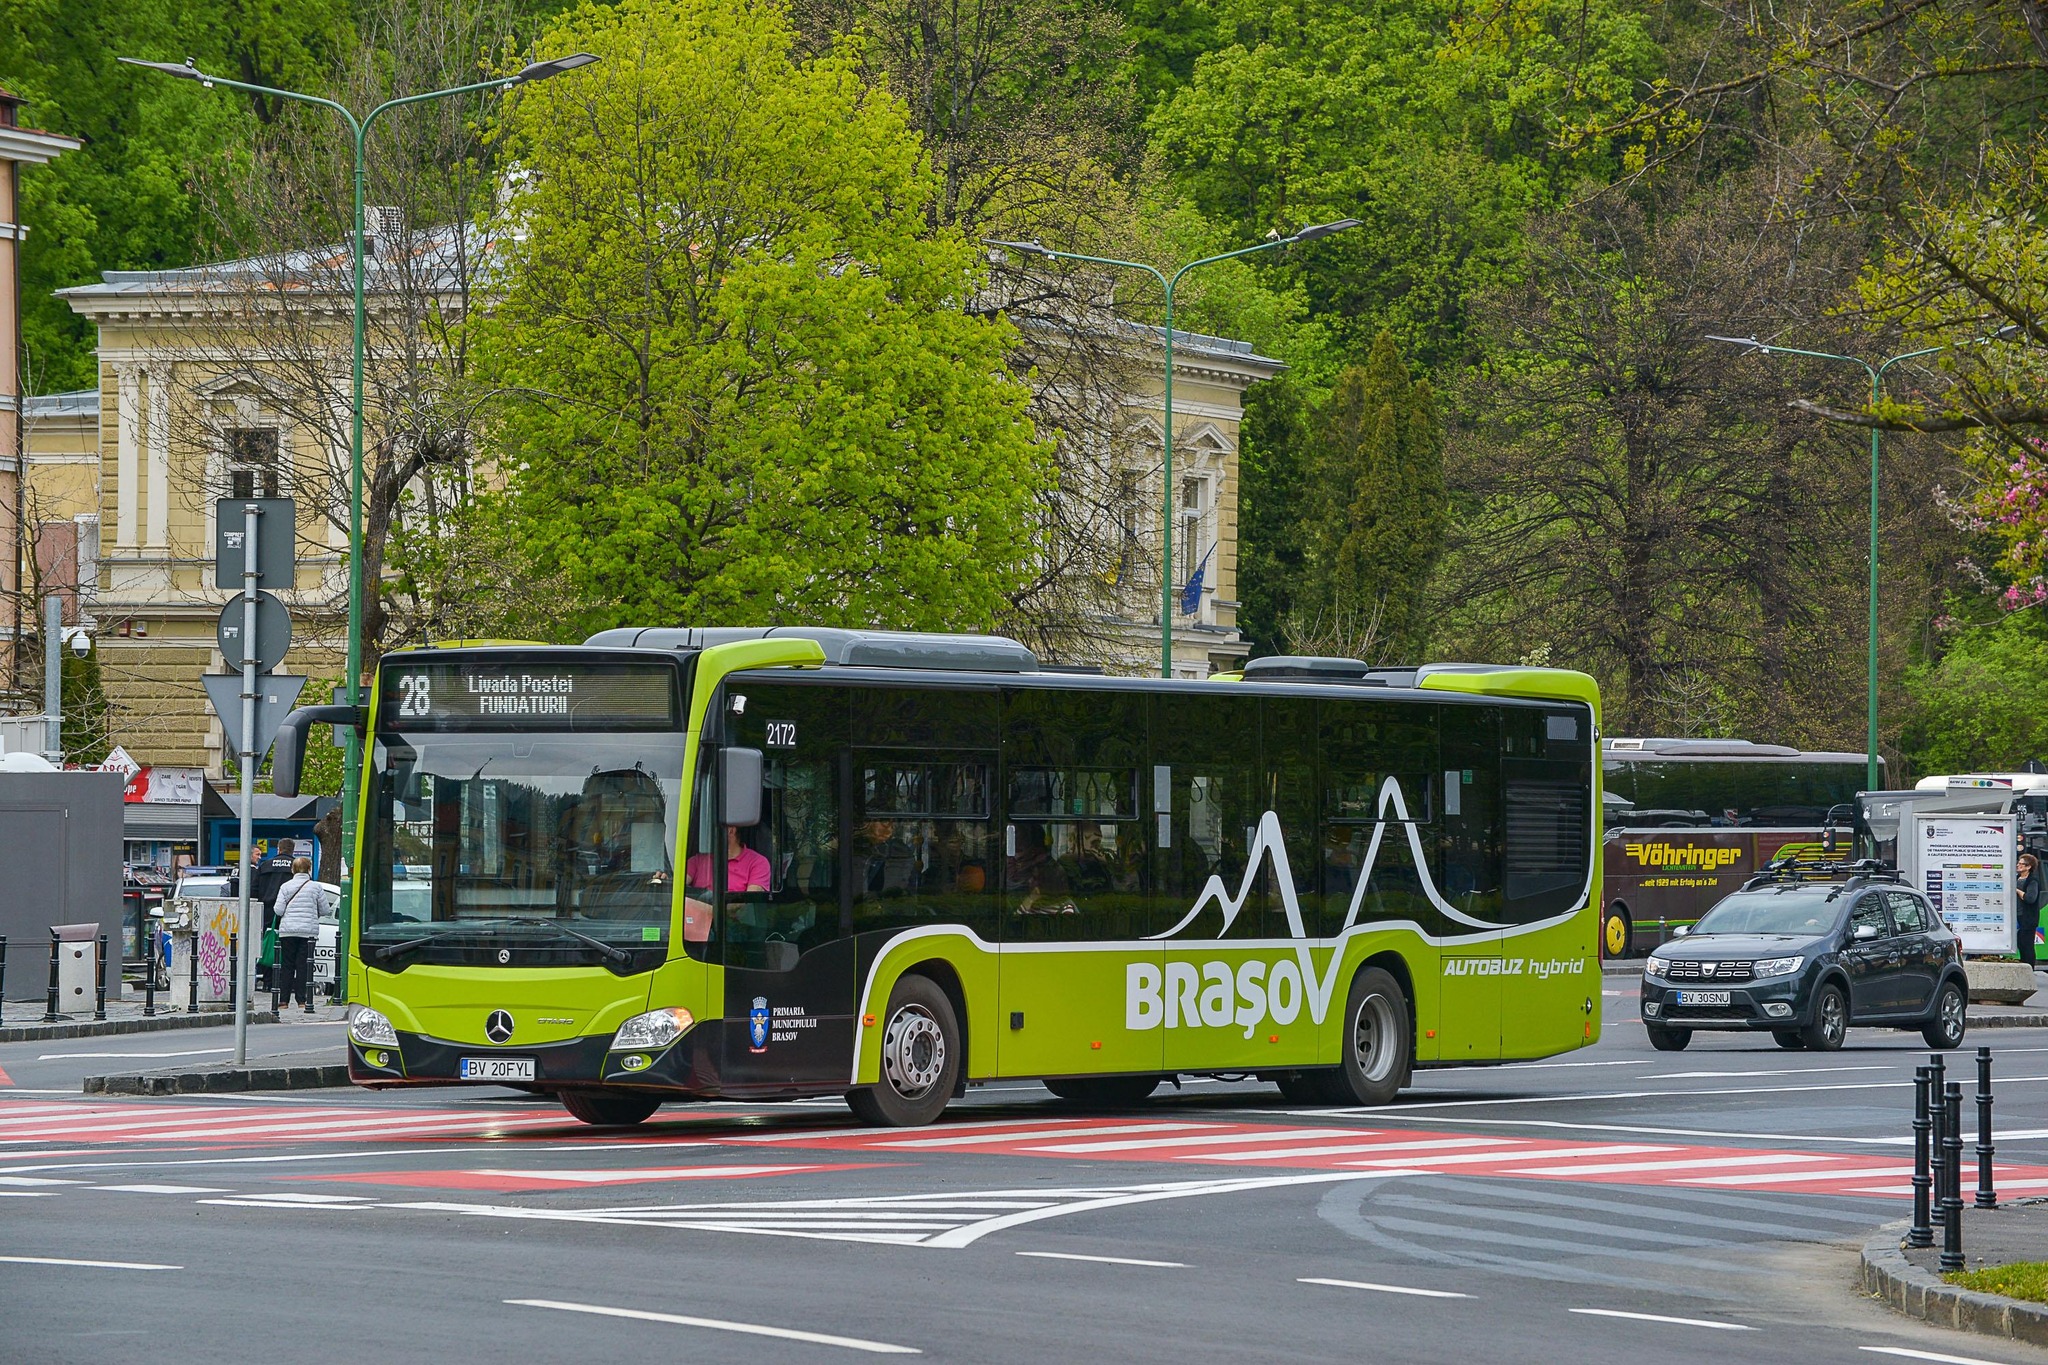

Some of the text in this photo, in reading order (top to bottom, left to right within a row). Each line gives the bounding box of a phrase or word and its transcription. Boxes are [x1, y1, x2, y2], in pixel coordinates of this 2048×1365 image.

[468, 675, 573, 693] Livada Postei
[399, 675, 430, 716] 28
[480, 696, 567, 714] FUNDATURII
[767, 723, 796, 746] 2172
[1625, 843, 1741, 870] Vöhringer
[1444, 958, 1584, 979] AUTOBUZ hybrid
[1682, 993, 1728, 1003] BV 30SNU
[773, 1007, 804, 1016] PRIMARIA
[772, 1018, 817, 1029] MUNICIPIULUI
[772, 1032, 798, 1041] BRASOV
[469, 1062, 532, 1076] BV 20FYL
